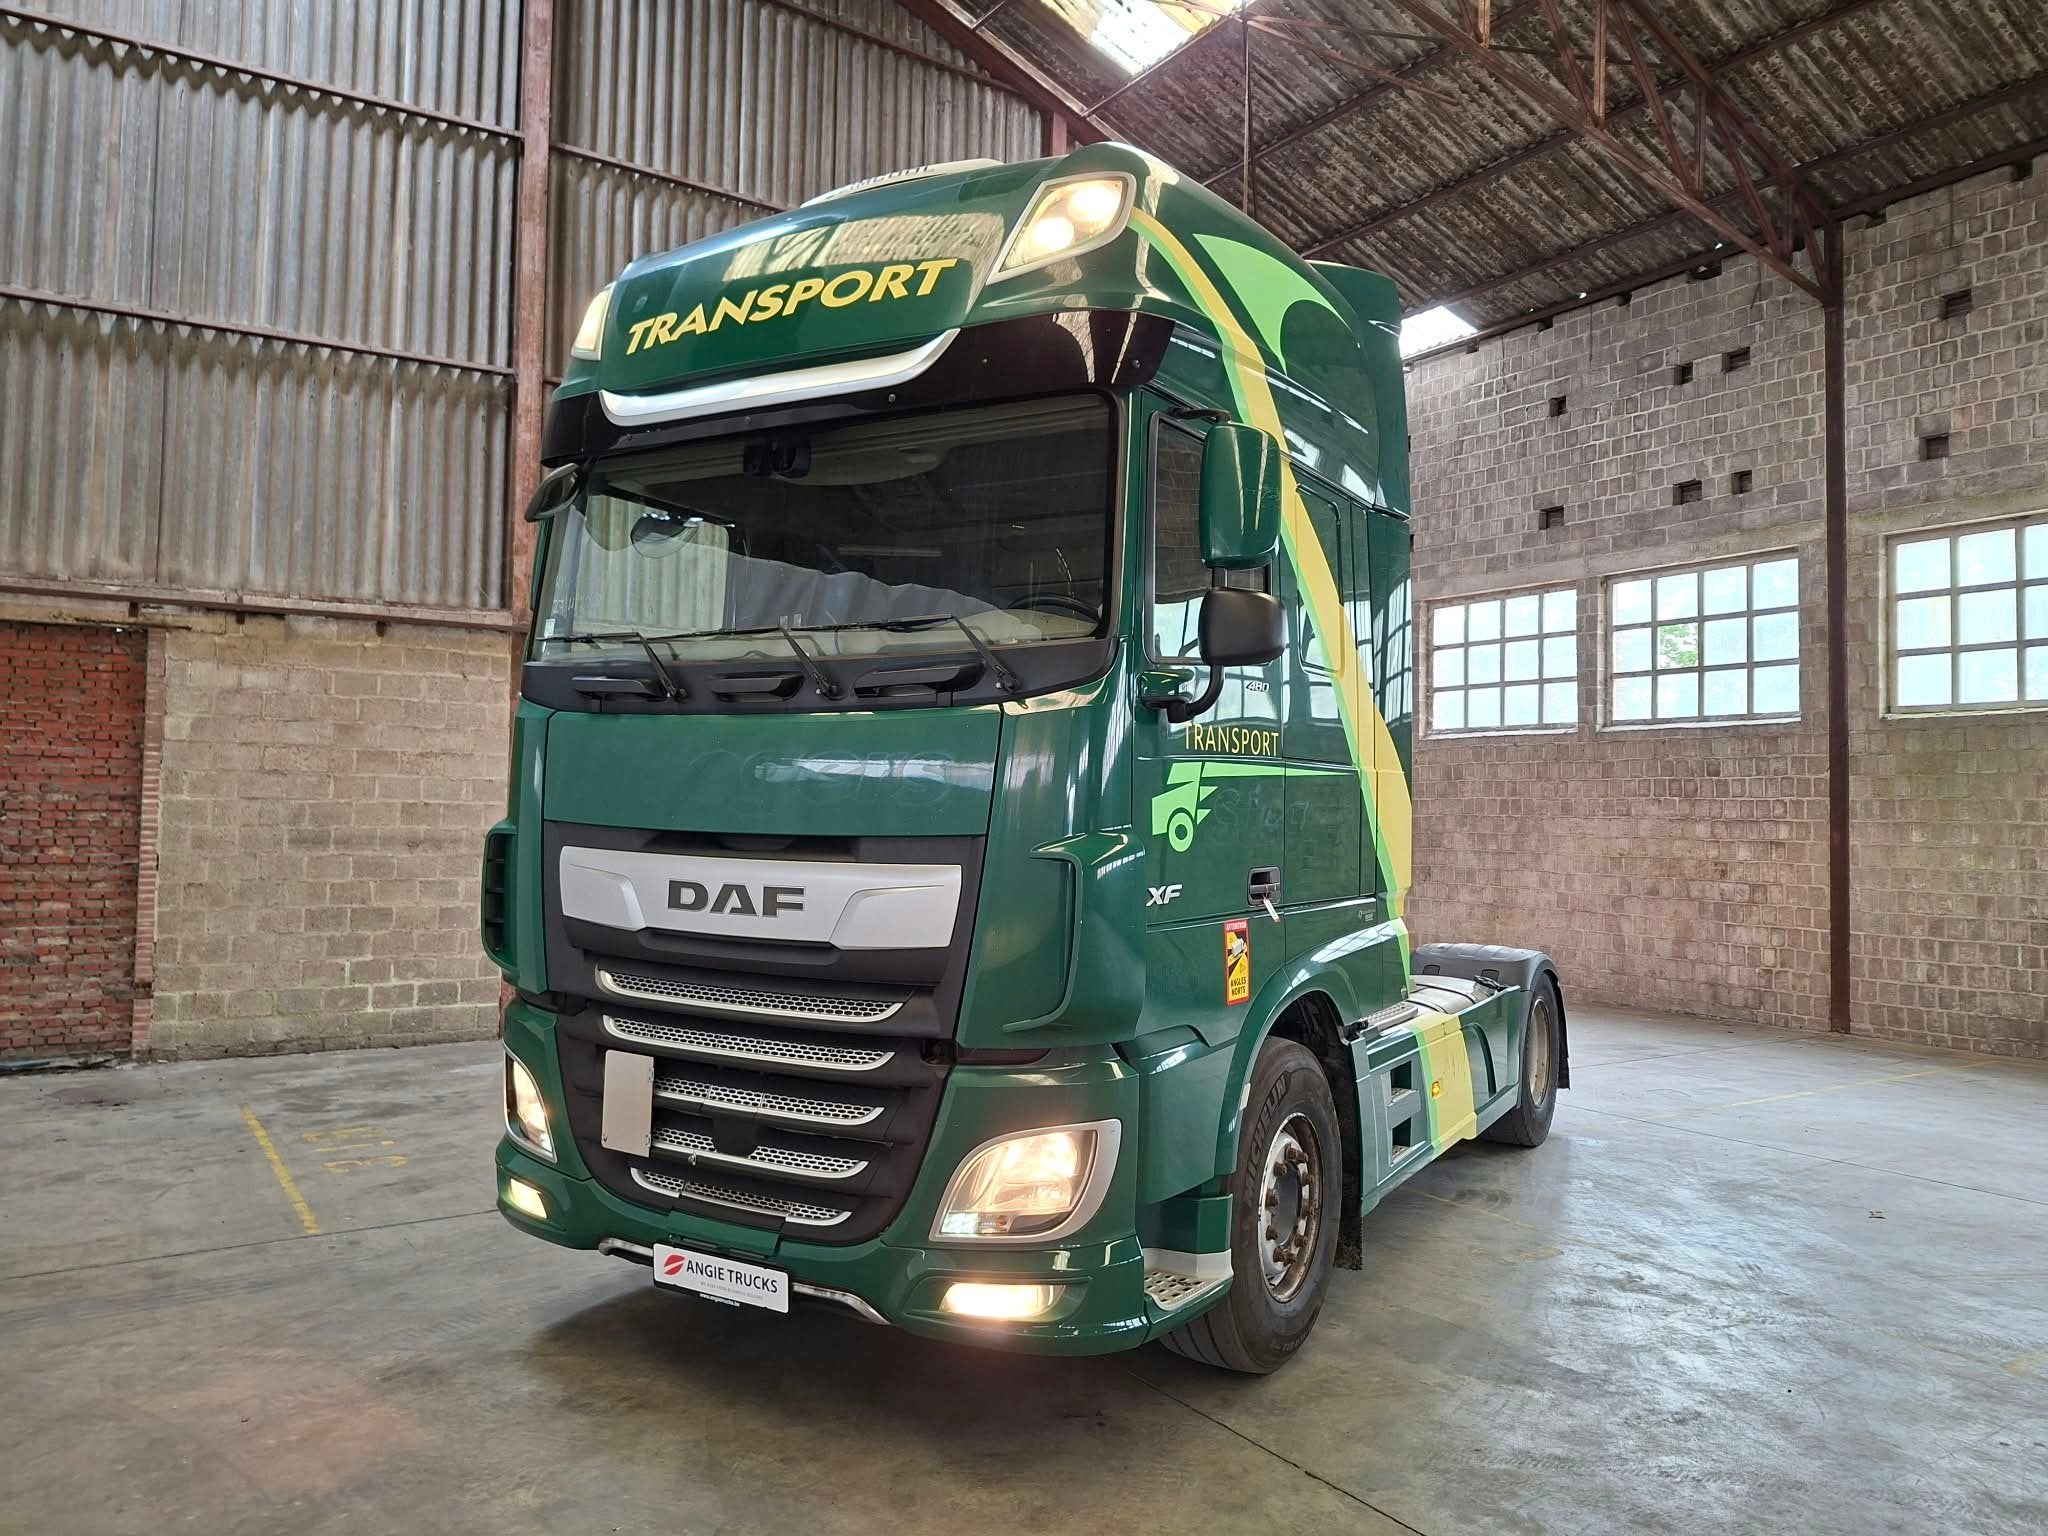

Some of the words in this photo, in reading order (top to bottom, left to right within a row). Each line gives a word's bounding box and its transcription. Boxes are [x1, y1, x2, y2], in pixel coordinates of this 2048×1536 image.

[626, 258, 957, 356] TRANSPORT
[1184, 721, 1279, 757] TRANSPORT
[668, 880, 804, 917] DAF
[1146, 884, 1182, 906] XF
[1245, 1073, 1290, 1194] MICHELIN
[686, 1259, 725, 1281] ANGIE
[728, 1269, 778, 1293] TRUCKS
